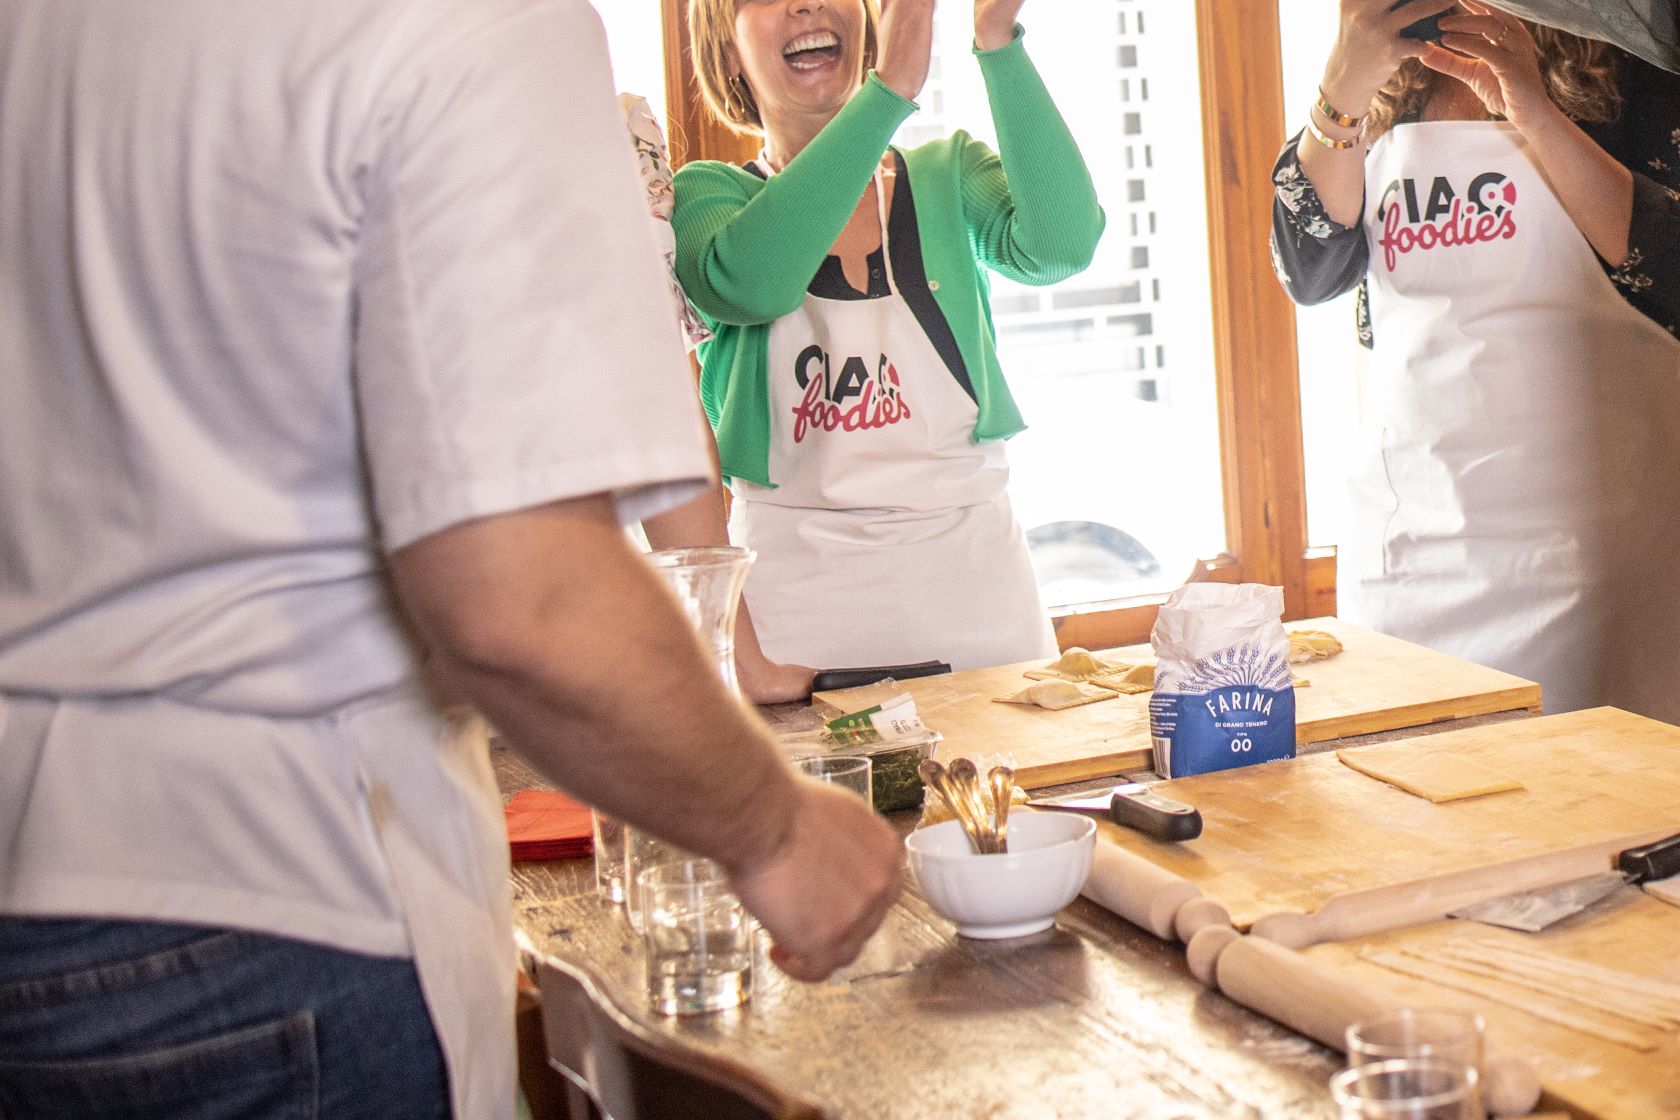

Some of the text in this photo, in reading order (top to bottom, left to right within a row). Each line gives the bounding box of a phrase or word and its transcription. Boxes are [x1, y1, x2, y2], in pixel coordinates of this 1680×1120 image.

[1377, 171, 1517, 224] CIAO
[1379, 198, 1517, 272] foodies
[791, 372, 911, 443] foodies
[1206, 691, 1275, 718] FARINA
[1245, 720, 1268, 728] TENERO
